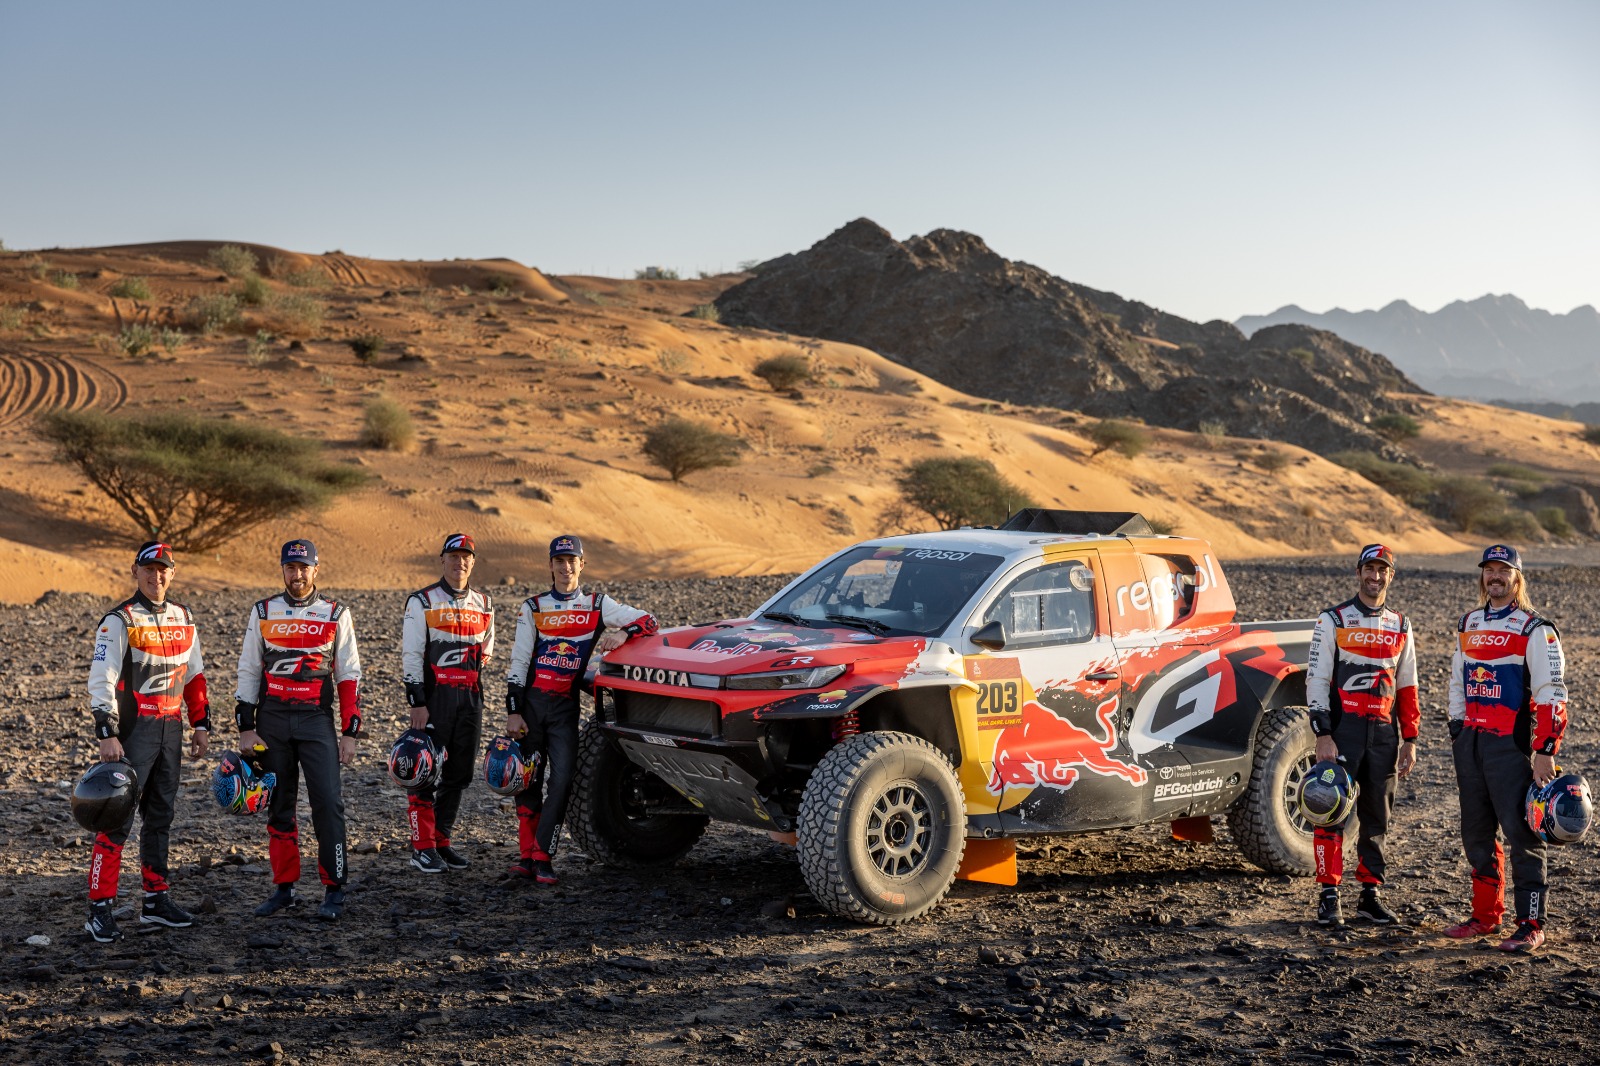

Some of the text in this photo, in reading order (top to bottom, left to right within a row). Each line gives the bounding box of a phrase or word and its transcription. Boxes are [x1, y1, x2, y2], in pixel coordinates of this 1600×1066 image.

[906, 549, 975, 562] repsol
[439, 612, 480, 624] repsol
[542, 613, 590, 627] repsol
[142, 629, 186, 643] repsol
[270, 623, 325, 636] repsol
[1347, 632, 1398, 645] repsol
[1467, 634, 1511, 647] repsol
[268, 653, 323, 675] GR
[537, 655, 581, 669] Red Bull
[770, 656, 814, 668] GR
[623, 664, 689, 688] TOYOTA
[977, 682, 1017, 714] 203
[1480, 684, 1501, 698] Bull
[807, 702, 842, 711] repsol
[1197, 768, 1215, 776] Services
[1153, 776, 1223, 798] BFGoodrich
[335, 843, 343, 879] sparco
[1317, 845, 1327, 876] sparc
[92, 852, 103, 889] sparco
[1529, 891, 1539, 920] arco
